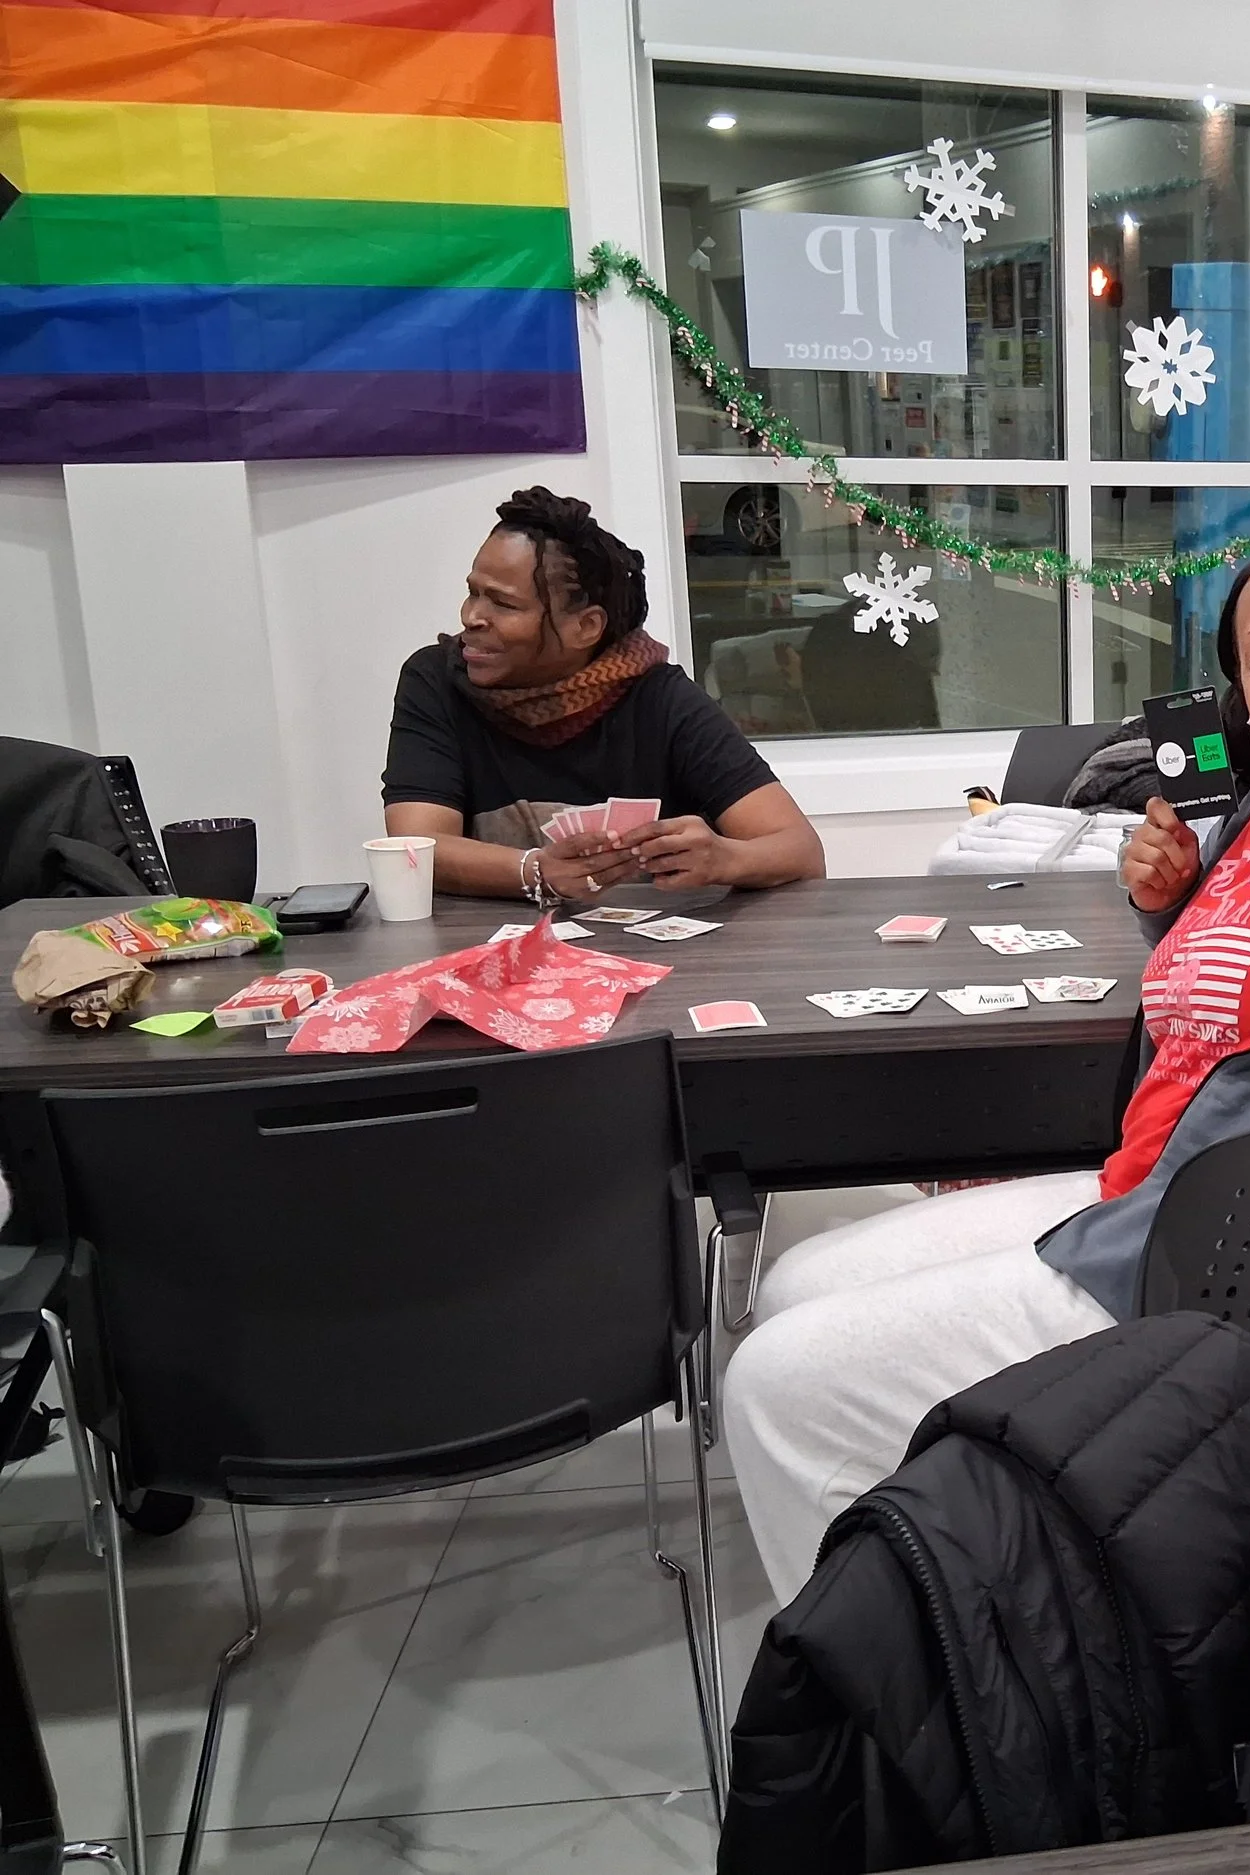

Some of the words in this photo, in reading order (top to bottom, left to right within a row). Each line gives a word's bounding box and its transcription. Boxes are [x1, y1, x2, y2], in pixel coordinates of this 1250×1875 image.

[1200, 743, 1219, 755] Uber
[1161, 755, 1180, 766] Uber
[1202, 752, 1221, 762] Eats
